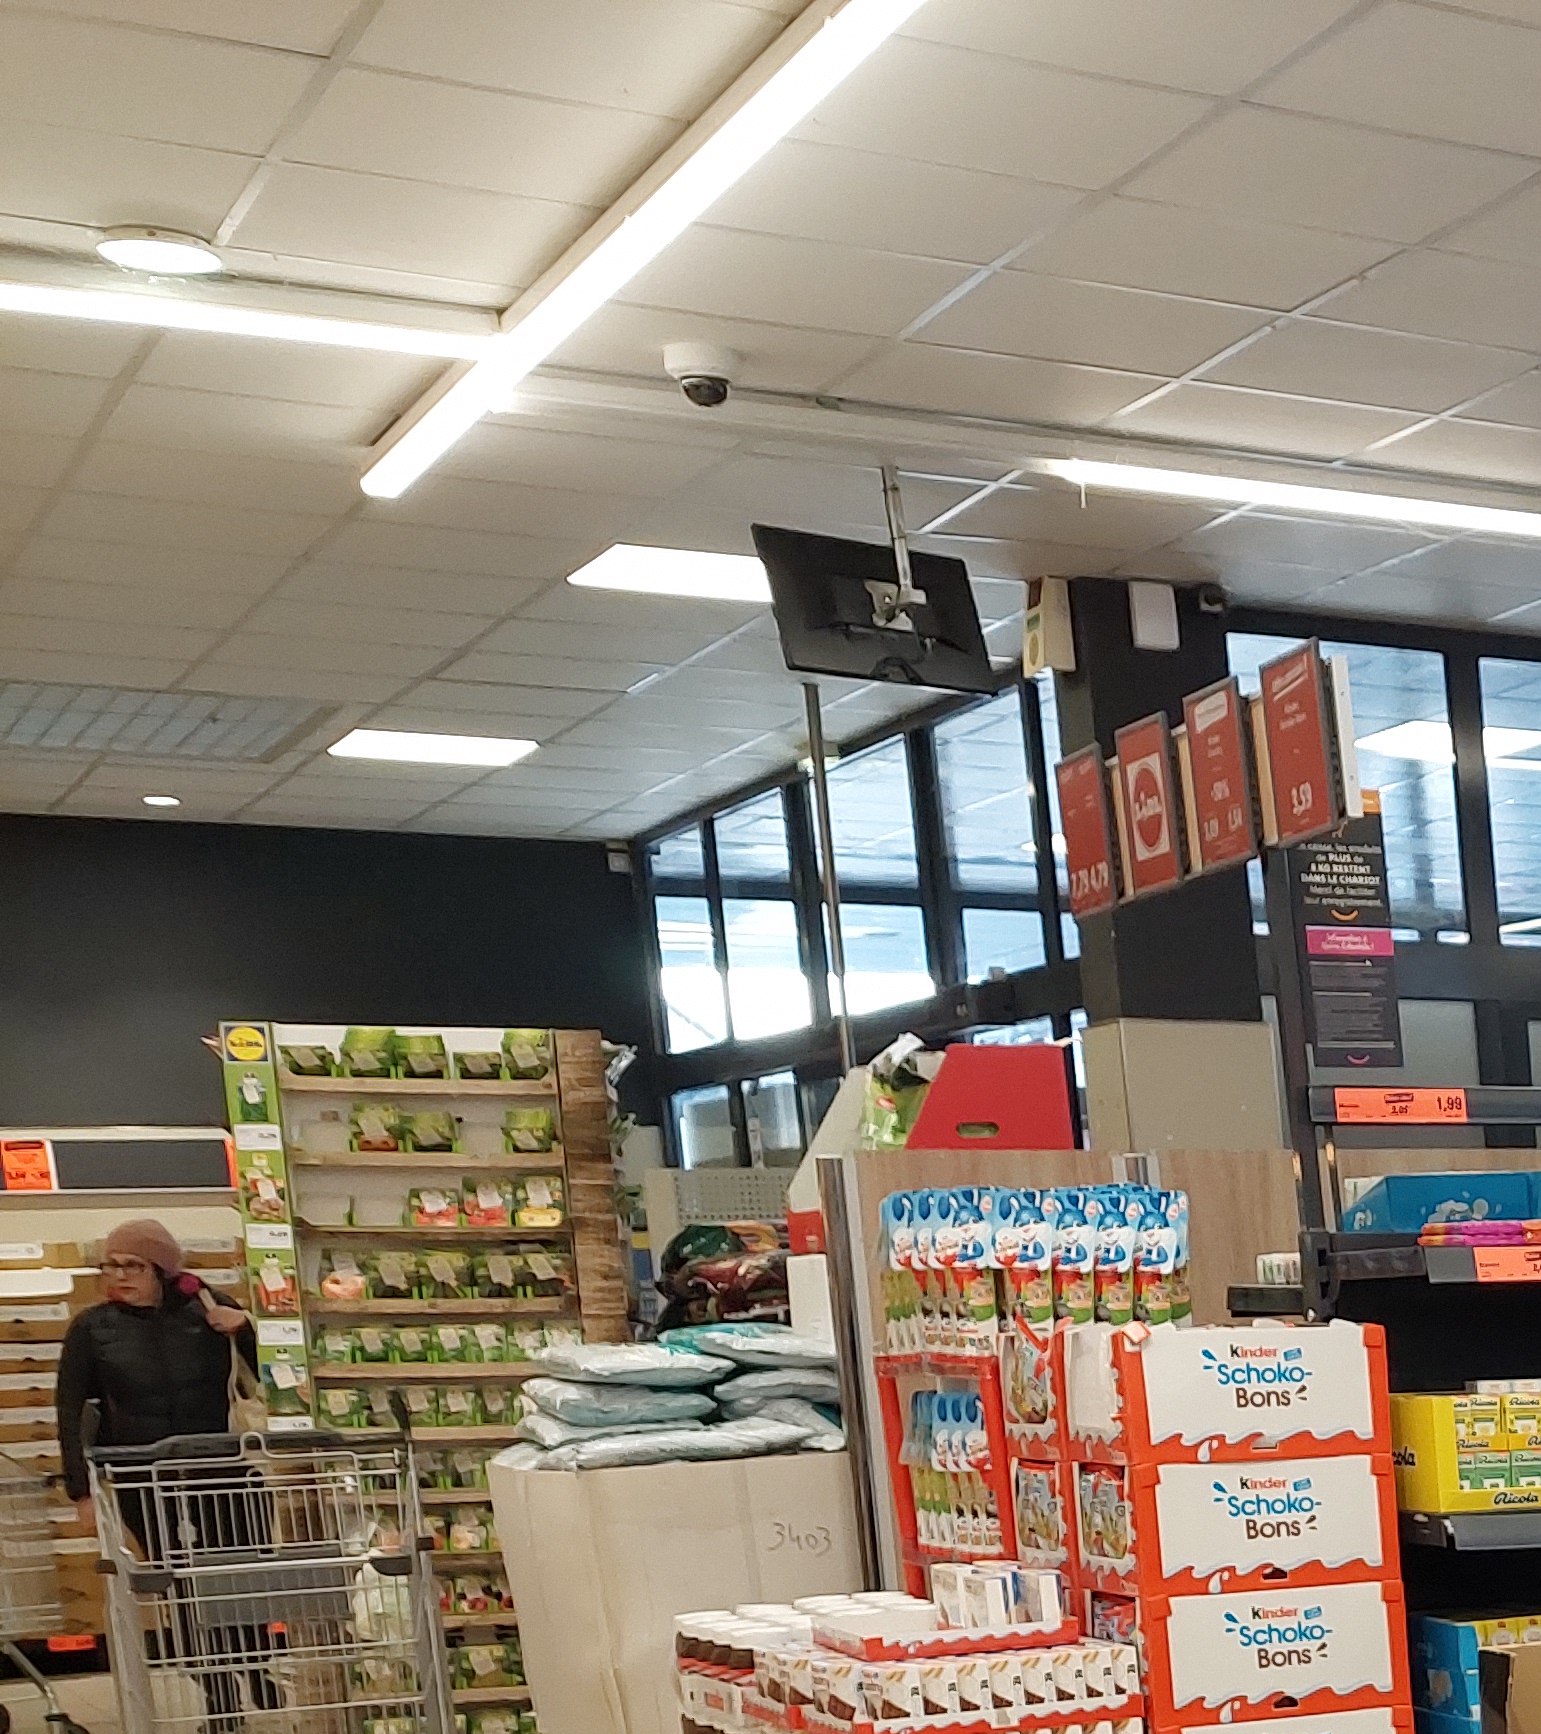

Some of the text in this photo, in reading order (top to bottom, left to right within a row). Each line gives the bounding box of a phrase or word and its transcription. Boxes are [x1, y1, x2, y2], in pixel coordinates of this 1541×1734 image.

[1217, 1362, 1313, 1385] Schoko-
[1236, 1387, 1291, 1408] Bons
[1228, 1492, 1322, 1517] Schoko-
[1493, 1491, 1540, 1506] Ricola
[770, 1522, 833, 1552] 3403
[1245, 1519, 1301, 1540] Bons
[1239, 1621, 1333, 1647] Schoko-
[1257, 1648, 1312, 1669] Bons
